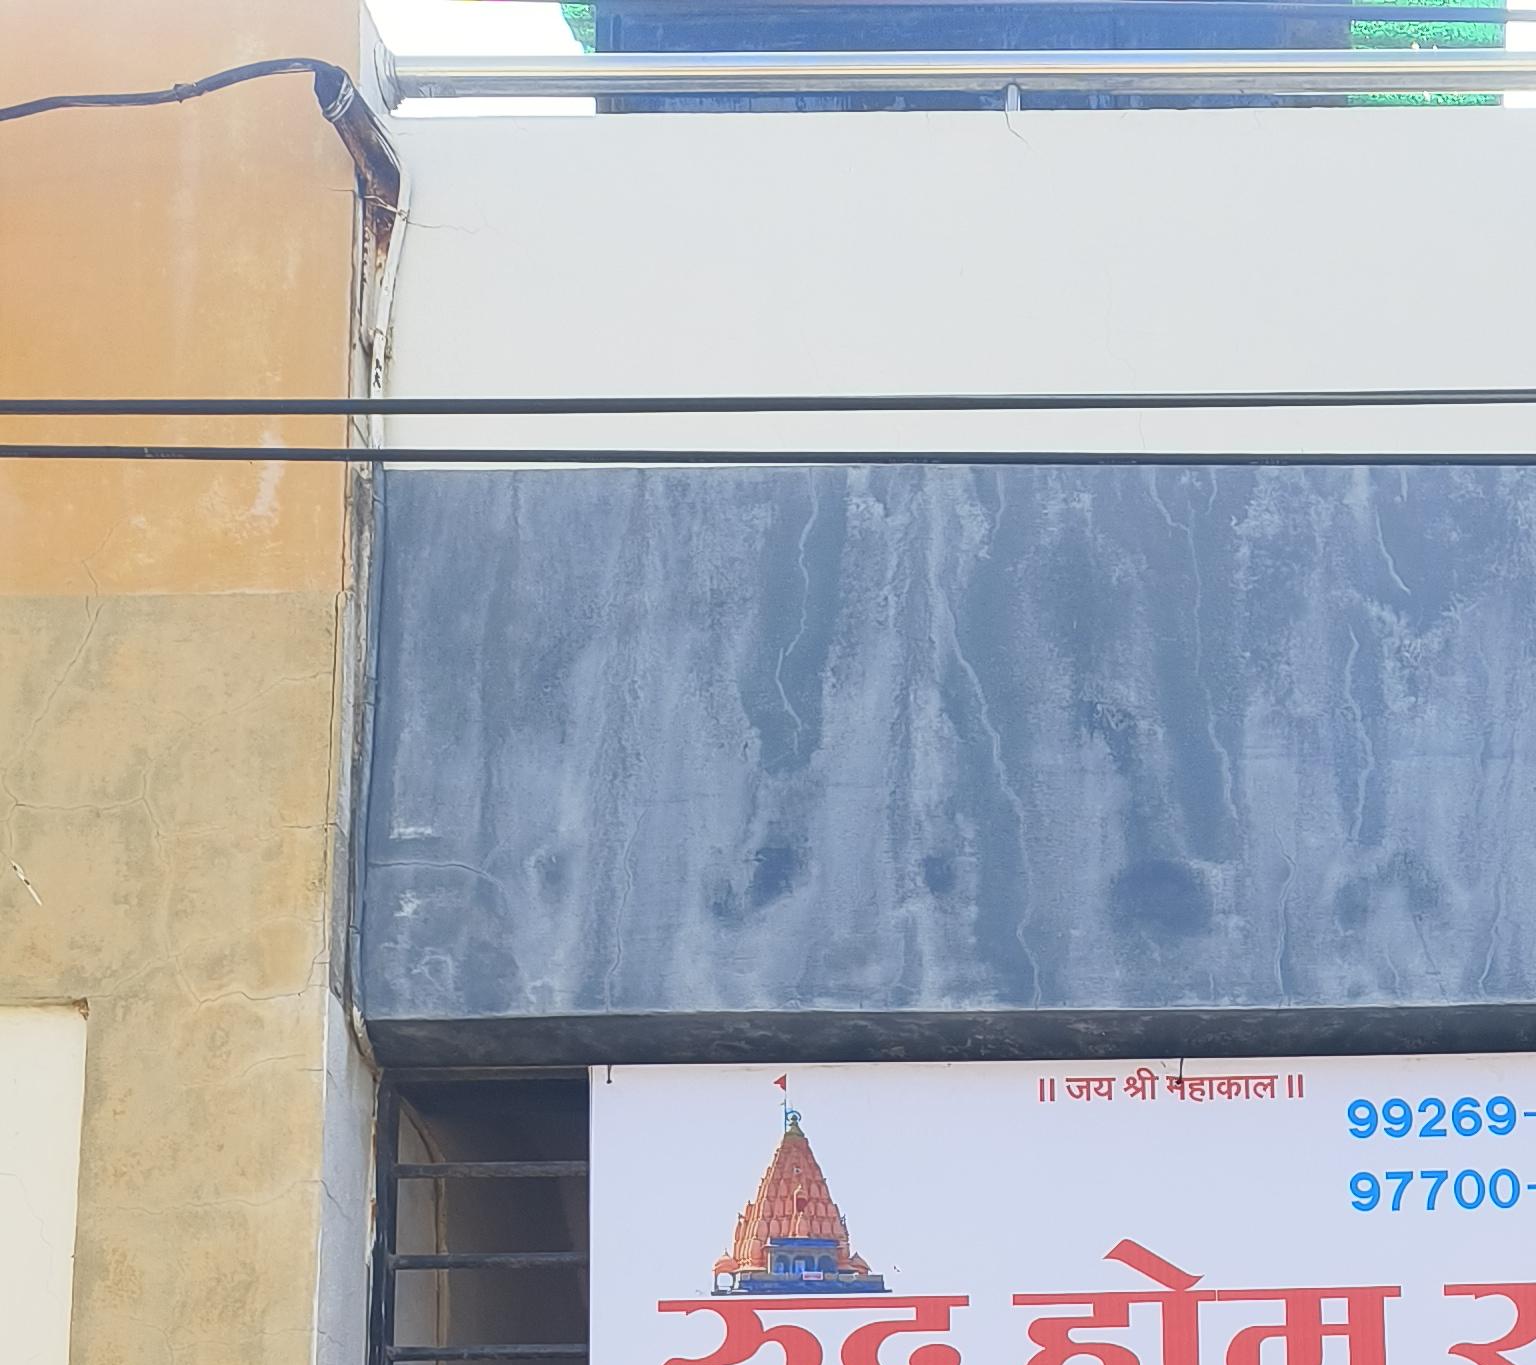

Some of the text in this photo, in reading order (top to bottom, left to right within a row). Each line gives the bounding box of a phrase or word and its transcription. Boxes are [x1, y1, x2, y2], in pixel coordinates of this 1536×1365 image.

[1065, 1076, 1117, 1101] जय
[1123, 1067, 1160, 1101] श्री
[1165, 1074, 1279, 1102] महाकाल
